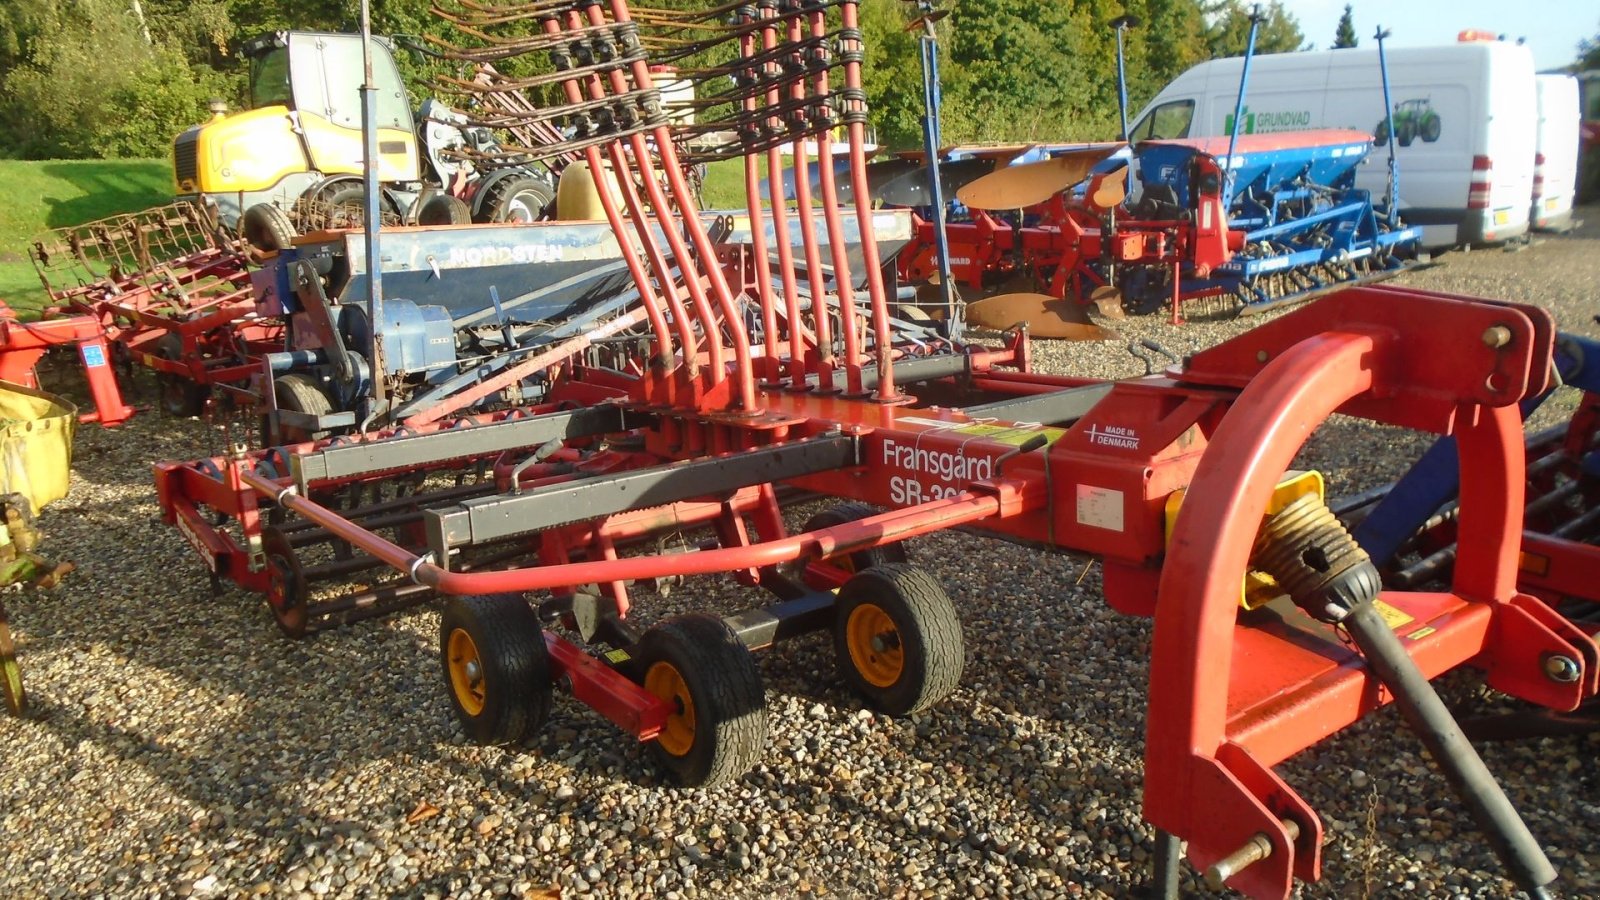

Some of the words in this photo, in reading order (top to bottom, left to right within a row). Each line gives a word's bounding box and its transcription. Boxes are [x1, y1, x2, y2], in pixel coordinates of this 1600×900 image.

[1257, 111, 1310, 127] GRUNDVAD
[450, 244, 563, 263] NORDSTEN
[1105, 425, 1126, 436] MADE
[1127, 428, 1135, 437] IN
[1097, 435, 1139, 450] DENMARK
[883, 438, 991, 481] Fransgård
